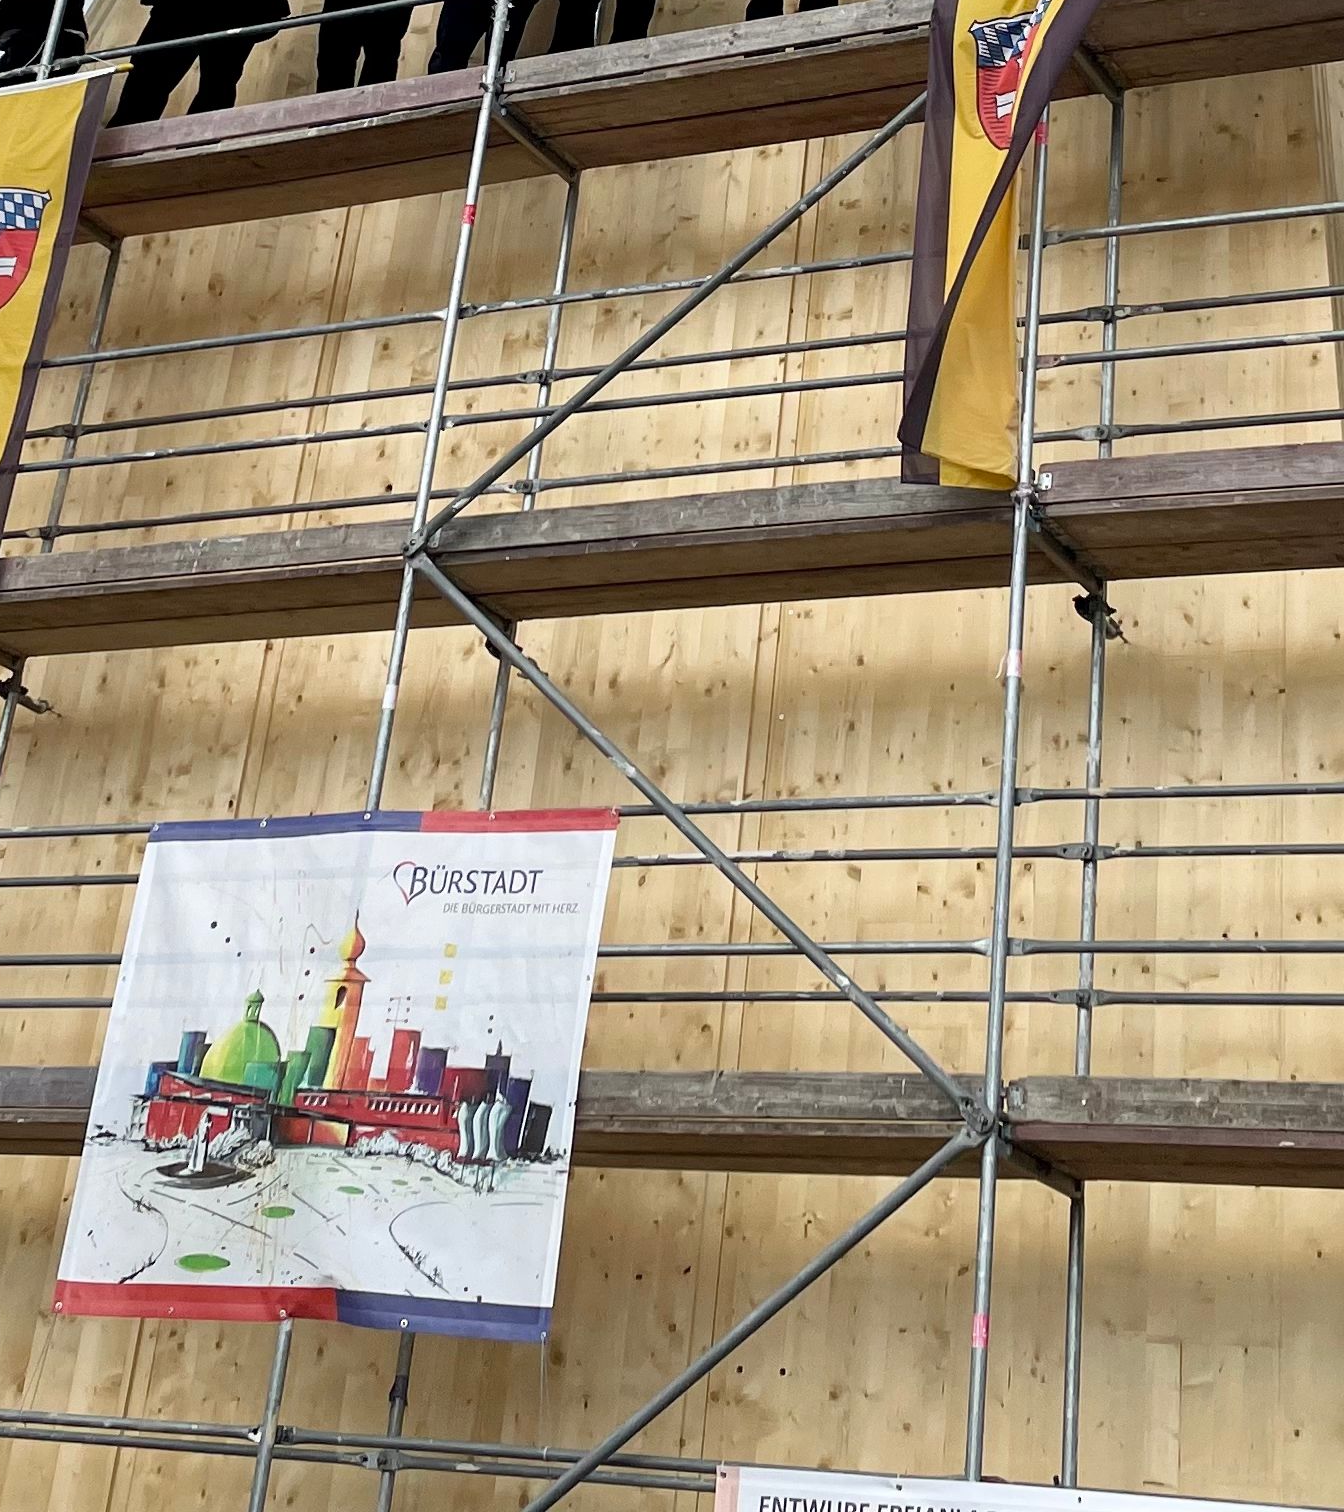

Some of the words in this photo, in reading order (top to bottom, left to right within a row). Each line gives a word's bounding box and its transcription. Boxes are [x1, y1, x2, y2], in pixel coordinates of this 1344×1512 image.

[408, 864, 544, 896] BÜRSTADT
[442, 902, 459, 914] DIE
[461, 901, 532, 915] BÜRGERSTADT
[532, 903, 550, 914] MIT
